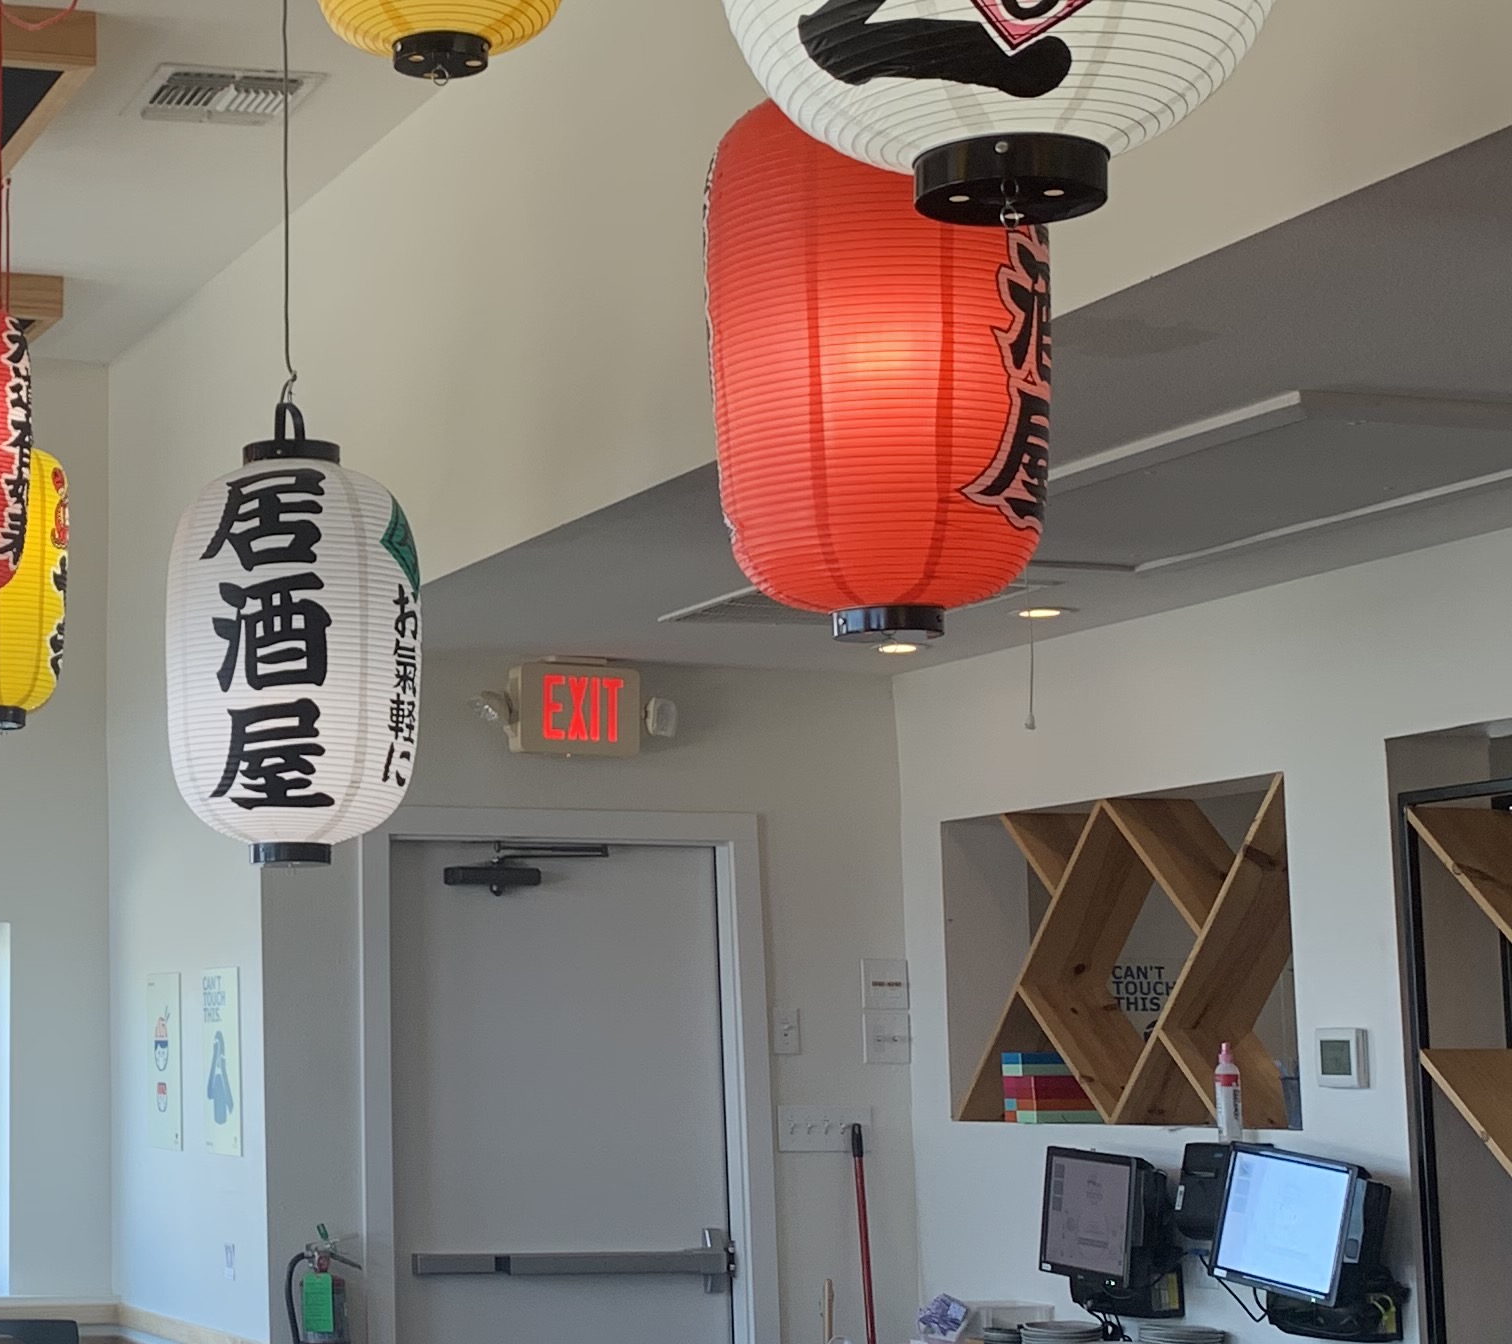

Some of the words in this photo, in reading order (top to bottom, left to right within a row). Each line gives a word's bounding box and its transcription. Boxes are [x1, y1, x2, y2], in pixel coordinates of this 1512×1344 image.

[199, 467, 335, 811] 居酒屋
[543, 674, 624, 743] EXIT
[1112, 965, 1165, 980] CAN'T
[202, 975, 222, 991] CAN'T
[1112, 981, 1176, 996] TOUCH
[203, 991, 226, 1007] TOUCH
[1114, 996, 1161, 1012] THIS
